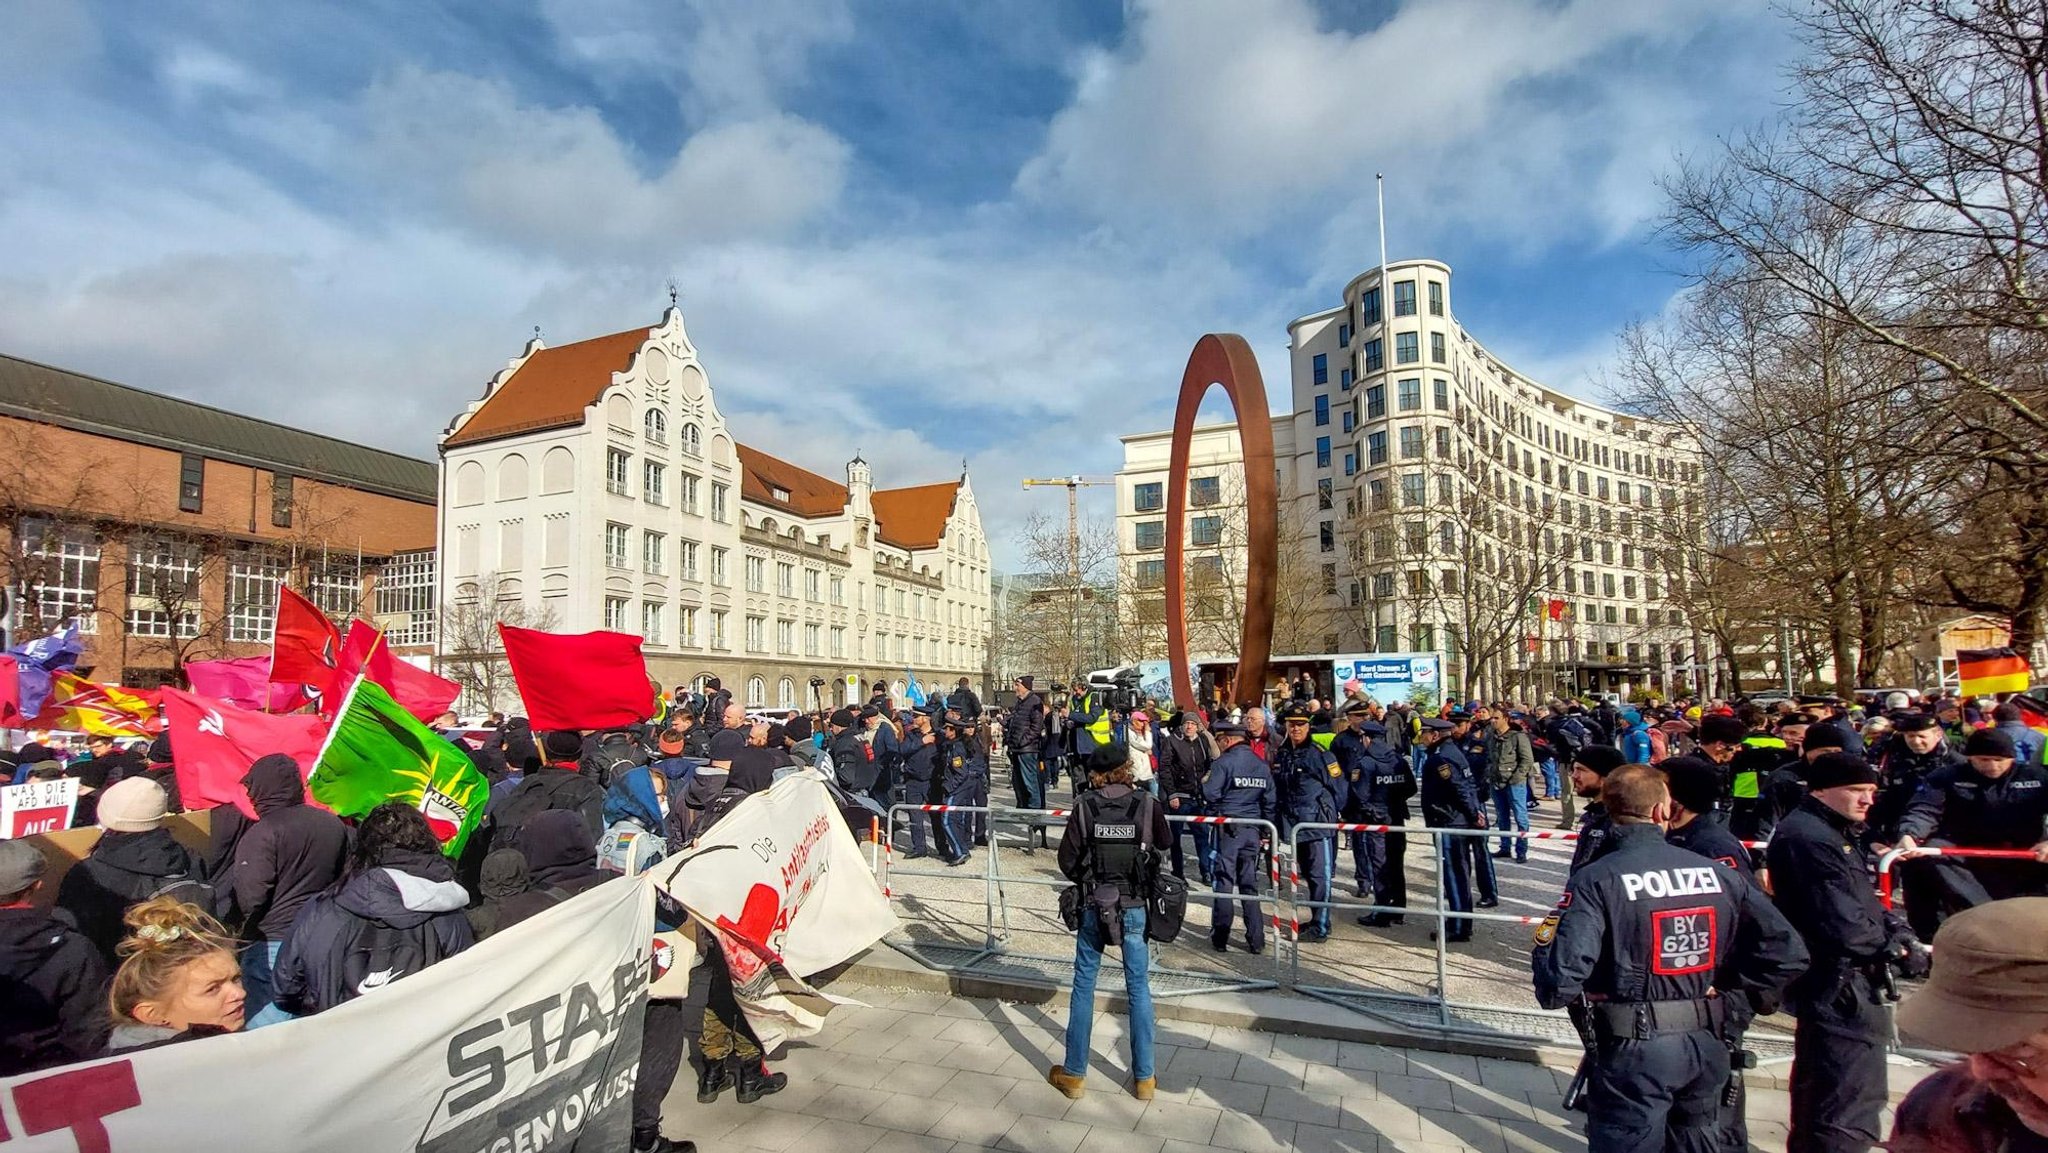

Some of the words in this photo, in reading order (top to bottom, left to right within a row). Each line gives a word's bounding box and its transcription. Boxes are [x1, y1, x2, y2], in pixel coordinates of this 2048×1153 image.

[1401, 664, 1407, 672] 2
[11, 785, 35, 798] WAS
[46, 782, 67, 794] DIE
[1235, 777, 1267, 789] POLIZEI
[18, 797, 38, 809] AFD
[1098, 826, 1133, 837] PRESSE
[751, 836, 777, 864] Die
[1621, 866, 1722, 901] POLIZEI
[1674, 914, 1697, 934] BY
[1663, 931, 1709, 952] 6213
